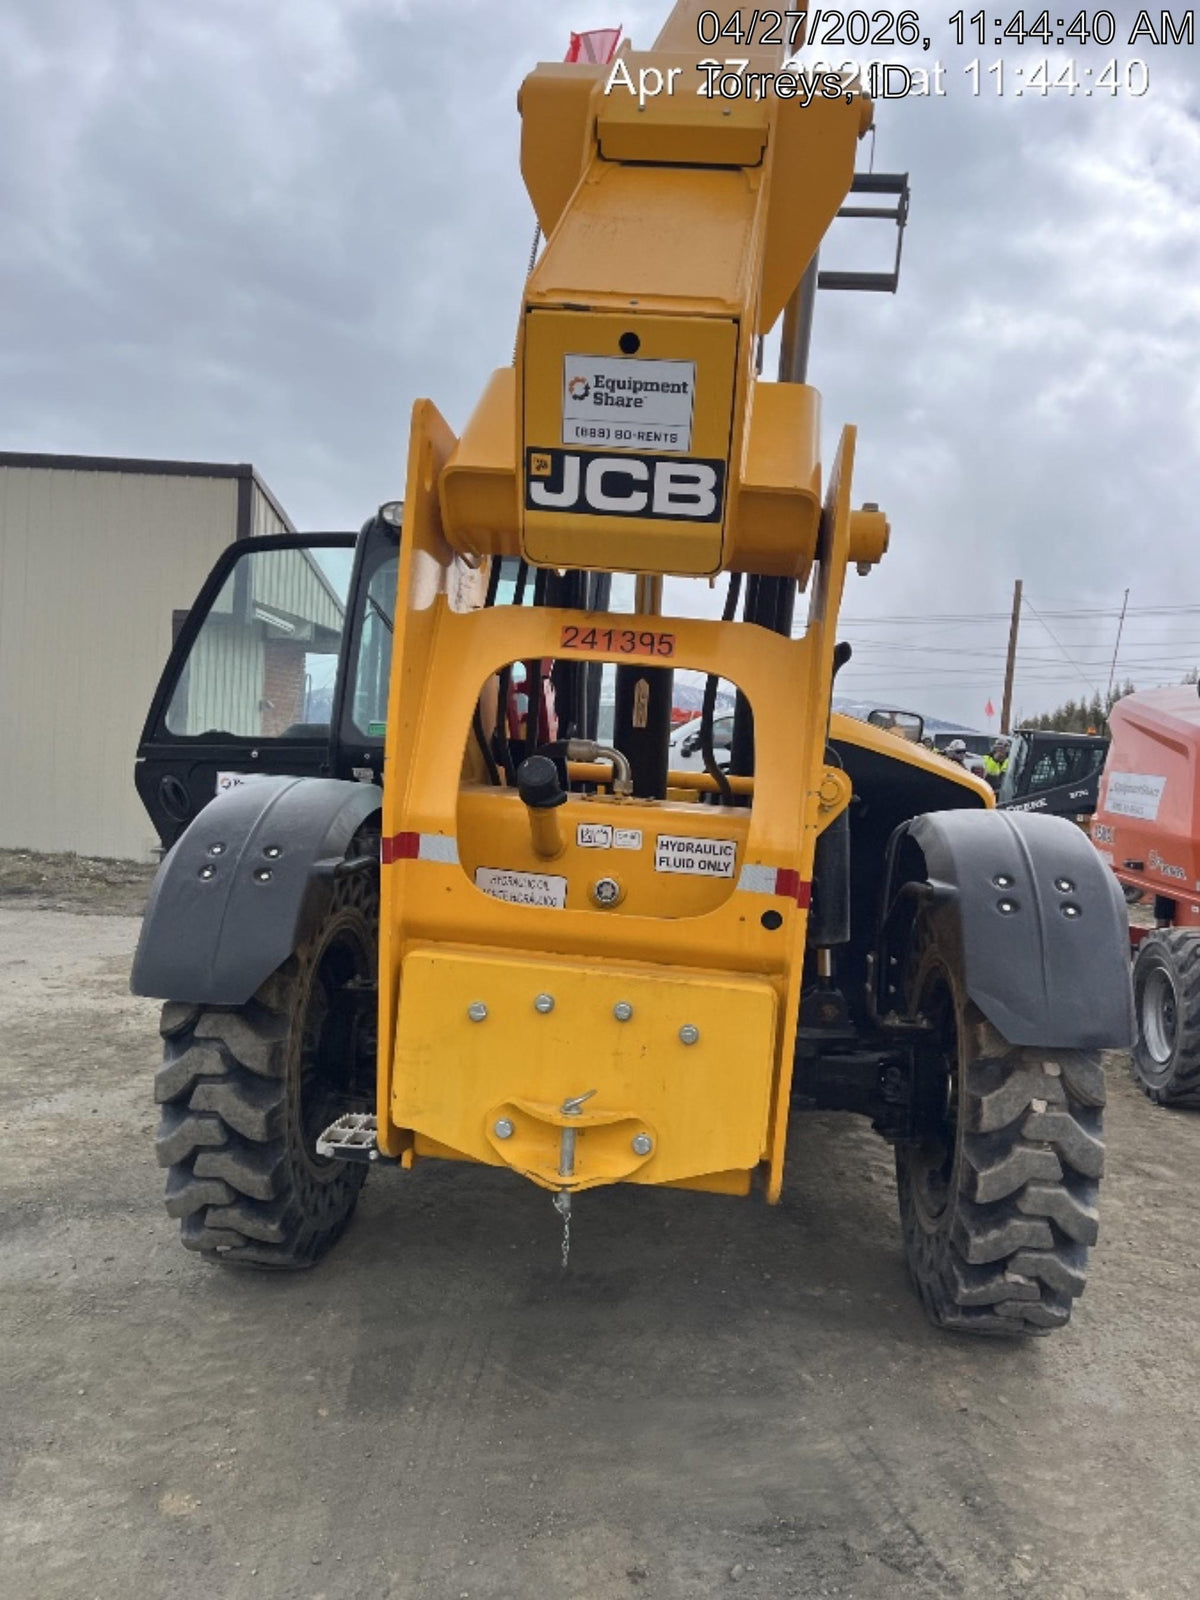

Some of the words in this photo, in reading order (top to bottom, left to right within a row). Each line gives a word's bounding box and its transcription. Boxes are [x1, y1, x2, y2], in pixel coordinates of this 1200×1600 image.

[593, 375, 689, 395] Equipment
[593, 392, 643, 408] Share
[615, 429, 678, 443] 80-RENTS
[529, 455, 717, 516] JCB
[562, 626, 674, 658] 241395
[660, 840, 733, 856] HYDRAULIC
[659, 857, 694, 869] FLUID
[698, 860, 731, 872] ONLY
